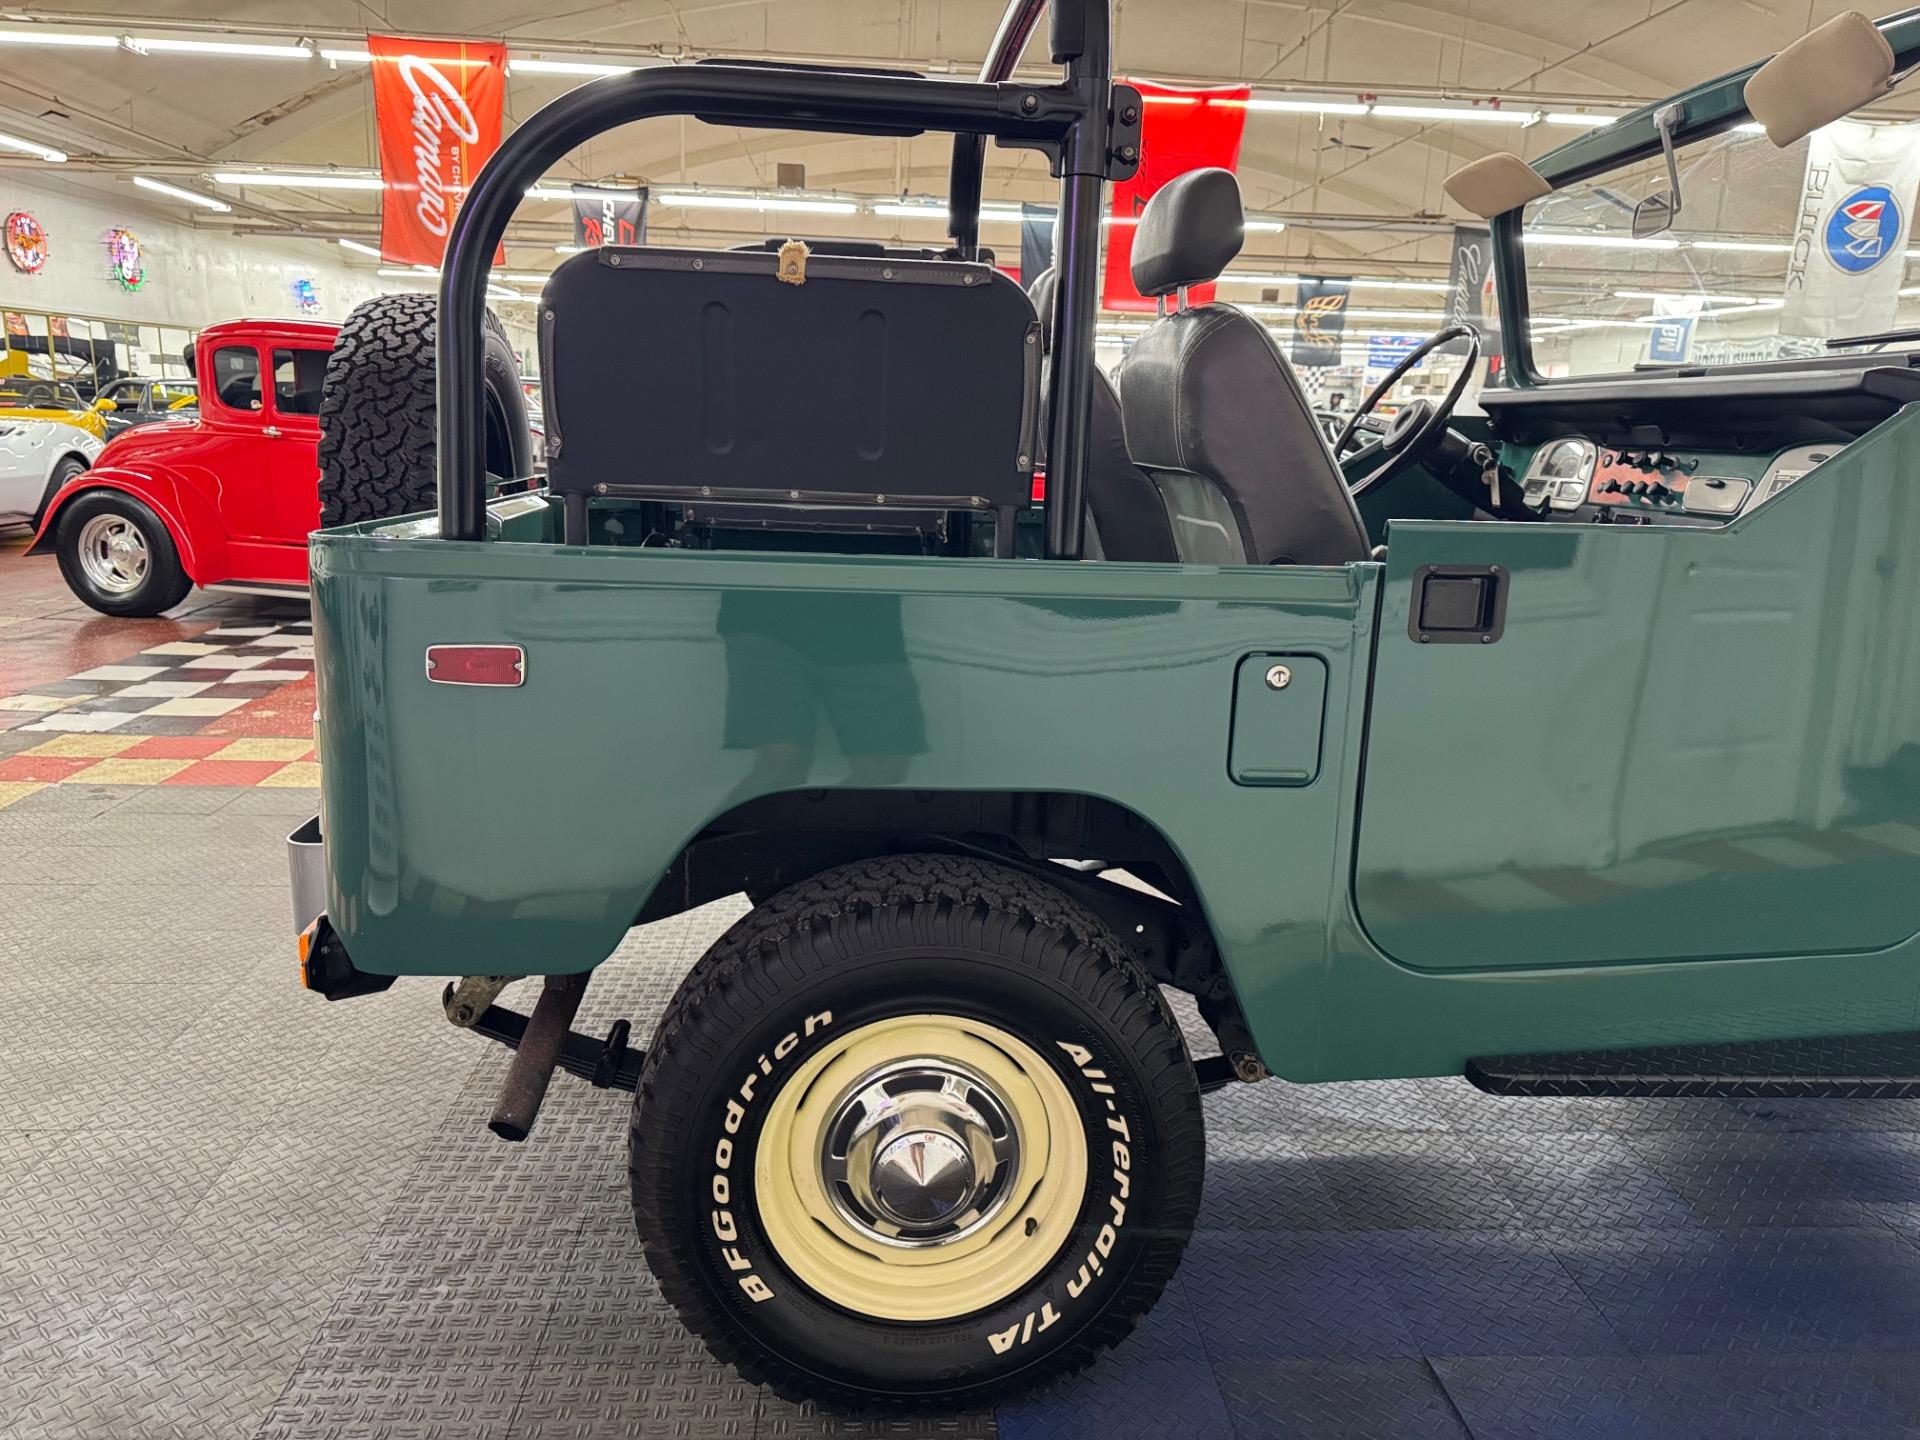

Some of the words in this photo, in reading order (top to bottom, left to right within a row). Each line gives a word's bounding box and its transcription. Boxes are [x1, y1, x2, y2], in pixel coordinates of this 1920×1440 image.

[398, 54, 479, 237] Camaro
[450, 145, 460, 164] BY
[602, 199, 616, 247] CHEV
[1787, 161, 1832, 290] BUICK
[1451, 243, 1480, 328] Cadilla
[712, 1009, 834, 1303] BFGoodrich
[1056, 1039, 1136, 1300] All-Terrain
[987, 1301, 1062, 1355] T/A
